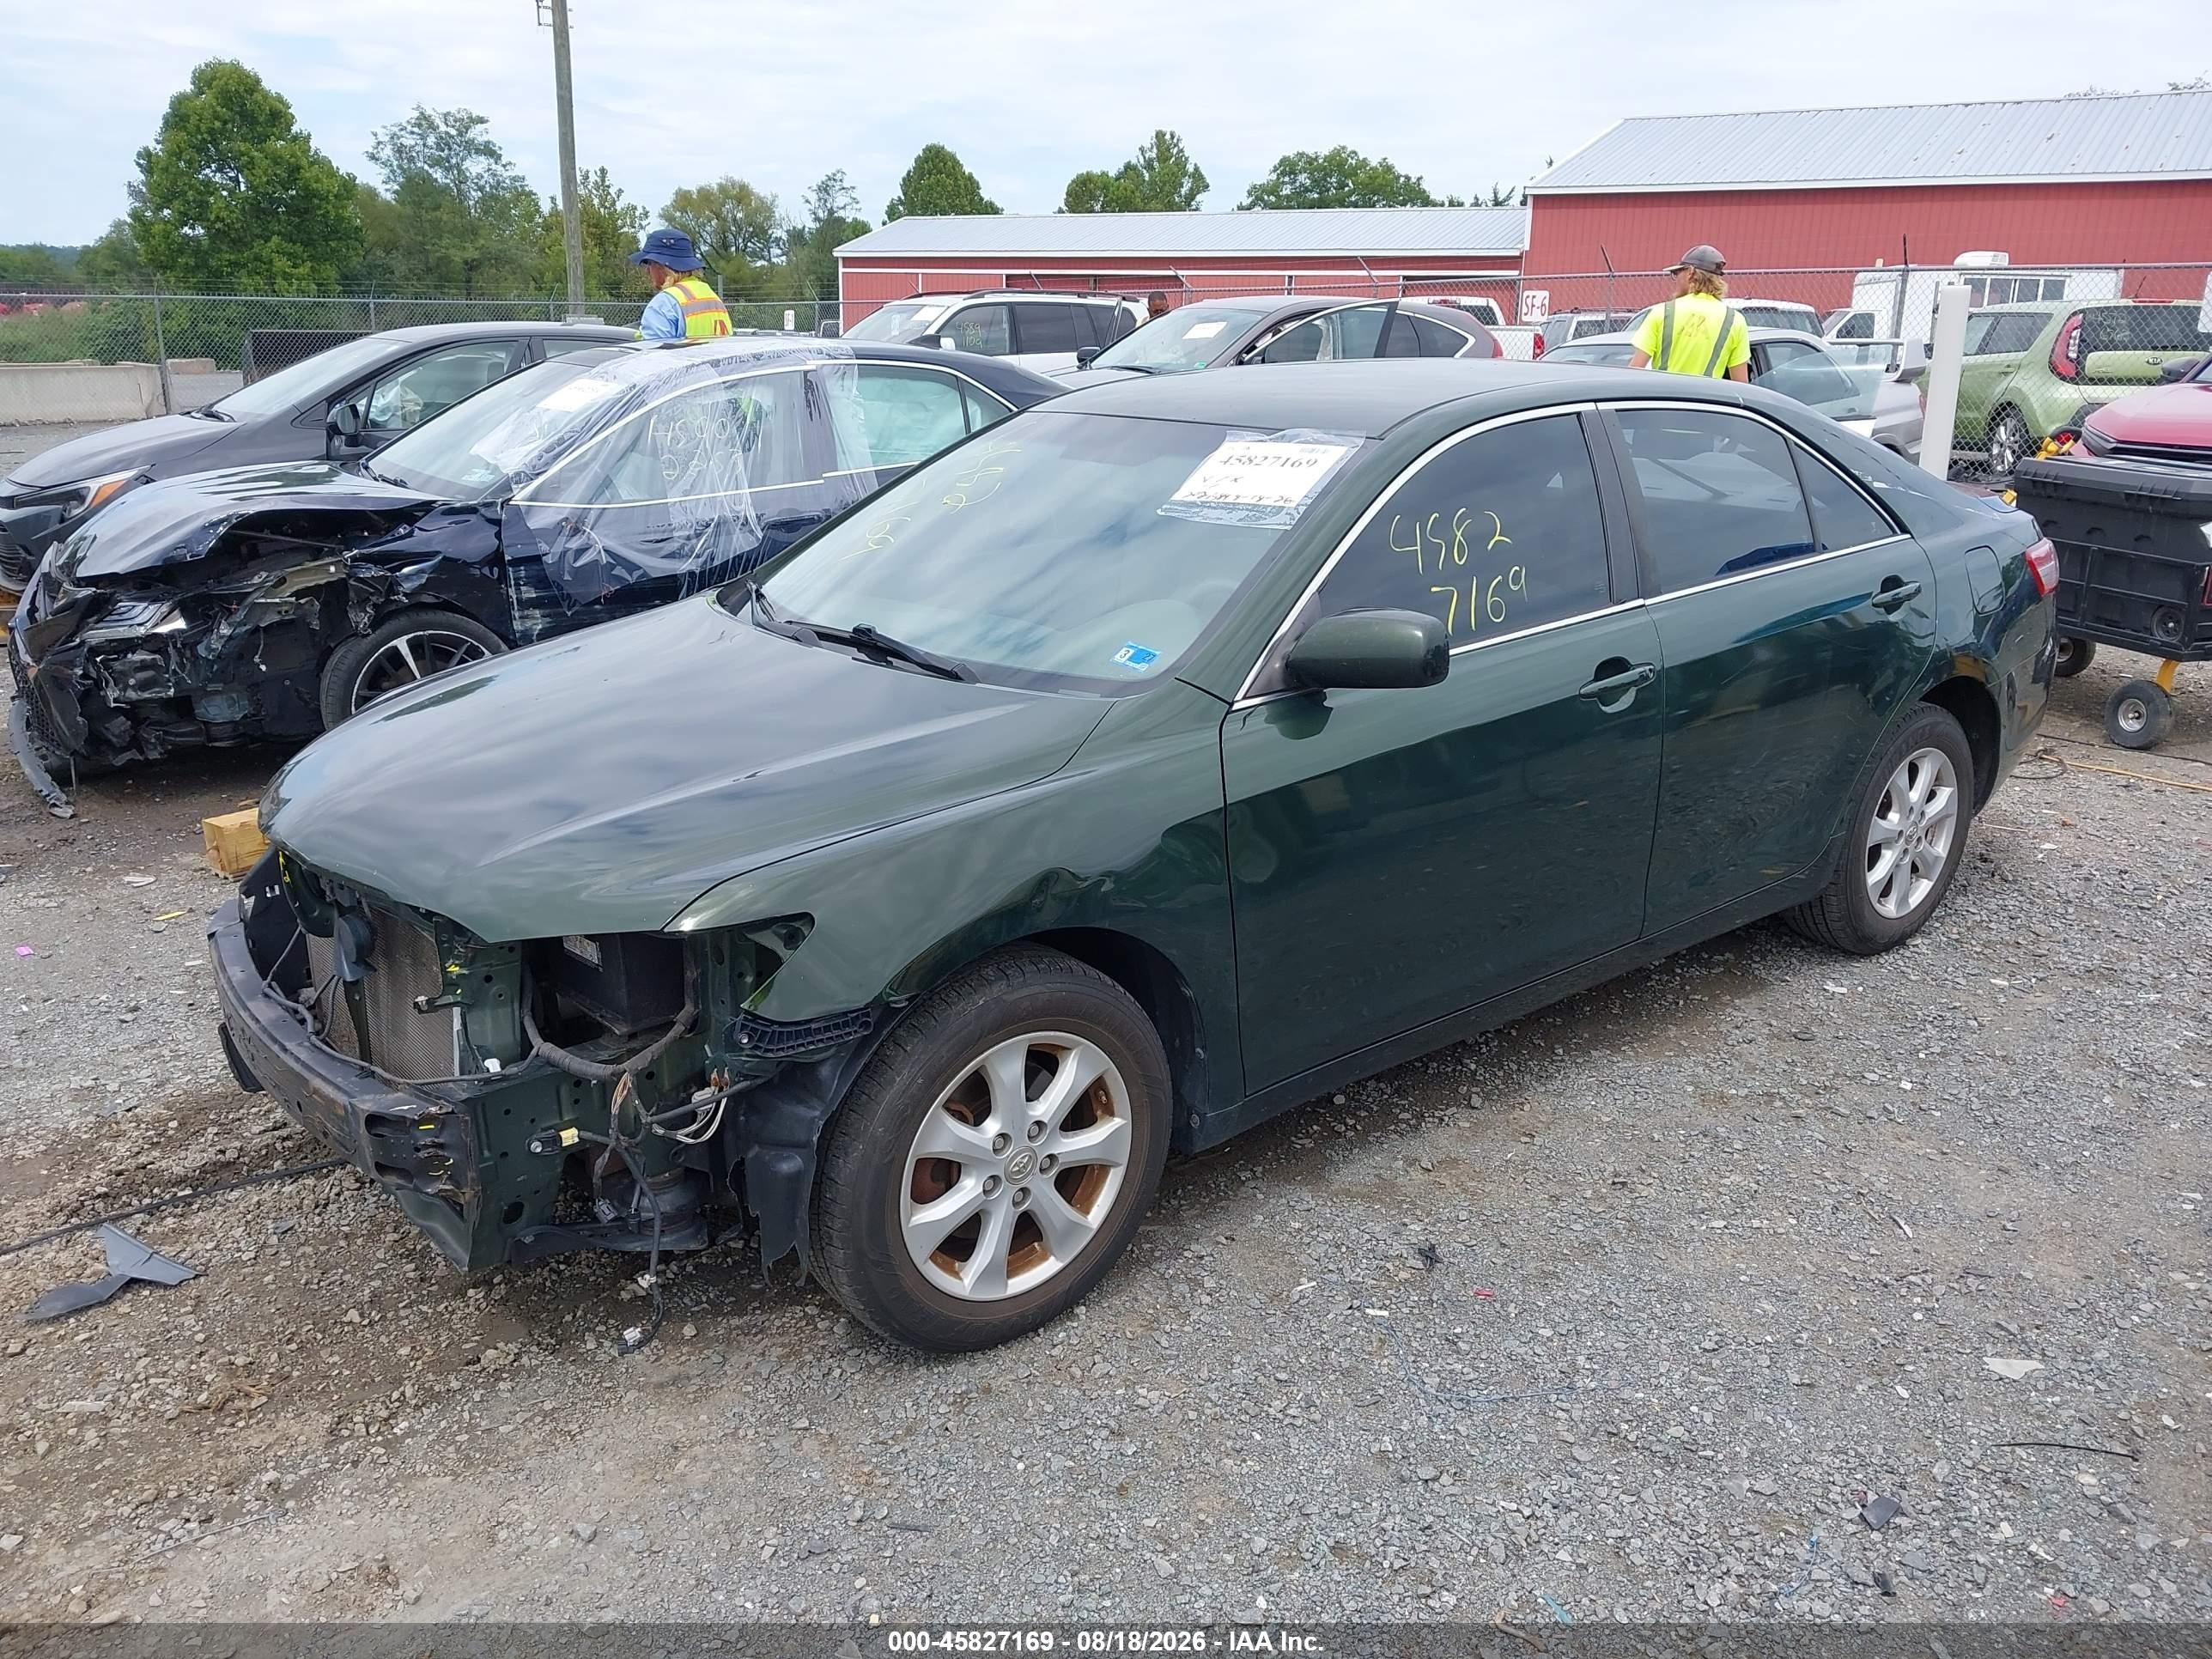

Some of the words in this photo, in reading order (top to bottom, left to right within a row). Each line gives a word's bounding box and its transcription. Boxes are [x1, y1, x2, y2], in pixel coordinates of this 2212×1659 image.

[1523, 295, 1547, 317] SF-6
[956, 322, 981, 337] 4589
[1218, 454, 1320, 469] 45827169
[1389, 507, 1513, 575] 4582
[1431, 565, 1528, 637] 7169
[1119, 649, 1130, 659] 3
[1142, 653, 1158, 662] 27
